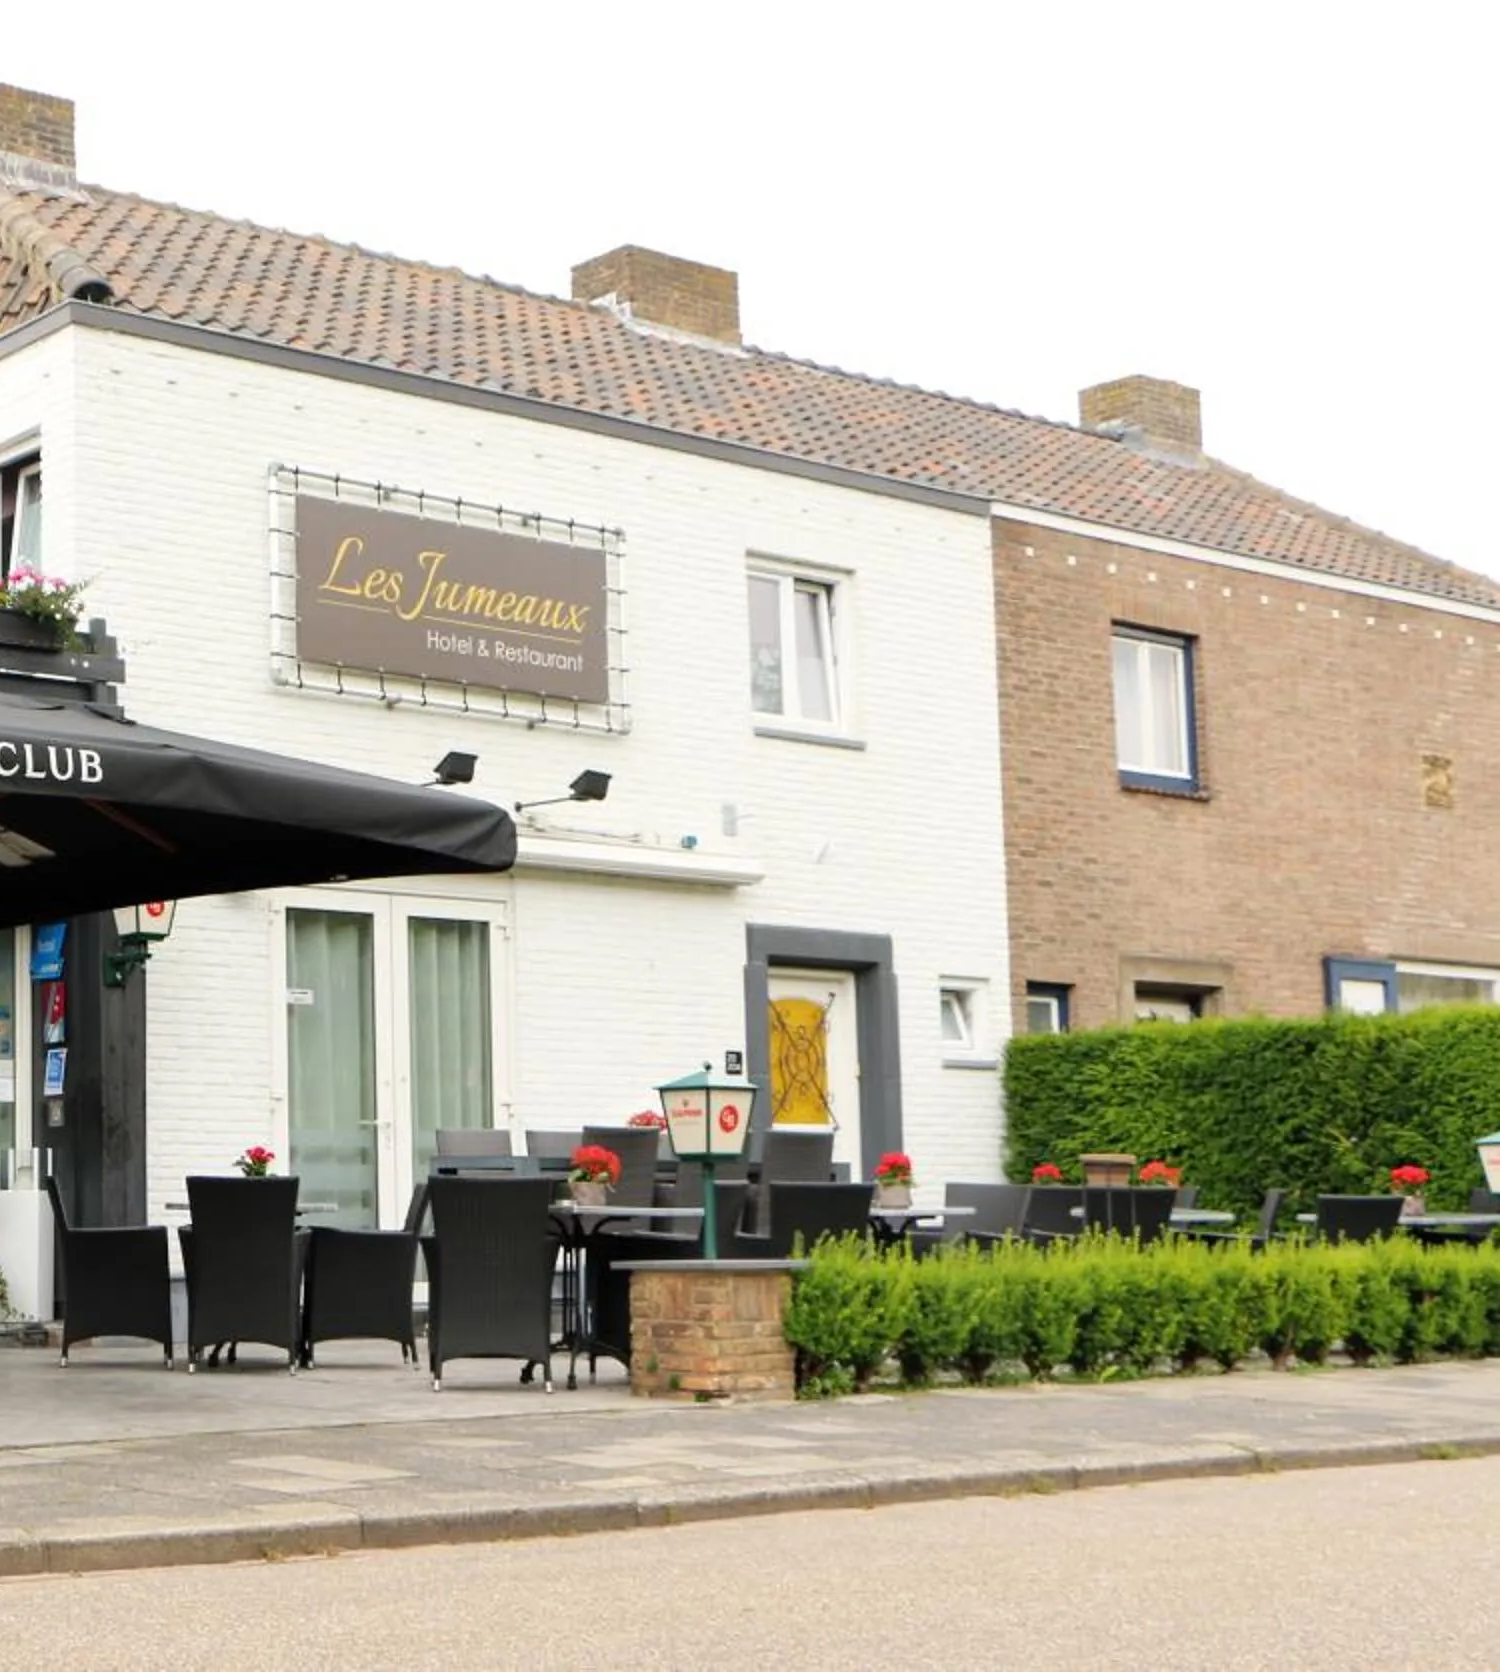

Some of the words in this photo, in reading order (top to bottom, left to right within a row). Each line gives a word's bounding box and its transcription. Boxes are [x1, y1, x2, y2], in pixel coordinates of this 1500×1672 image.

[318, 536, 404, 603] Les
[396, 550, 592, 634] Jumeaux
[426, 629, 474, 655] Hotel
[477, 640, 490, 658] &
[494, 641, 584, 673] Restaurant
